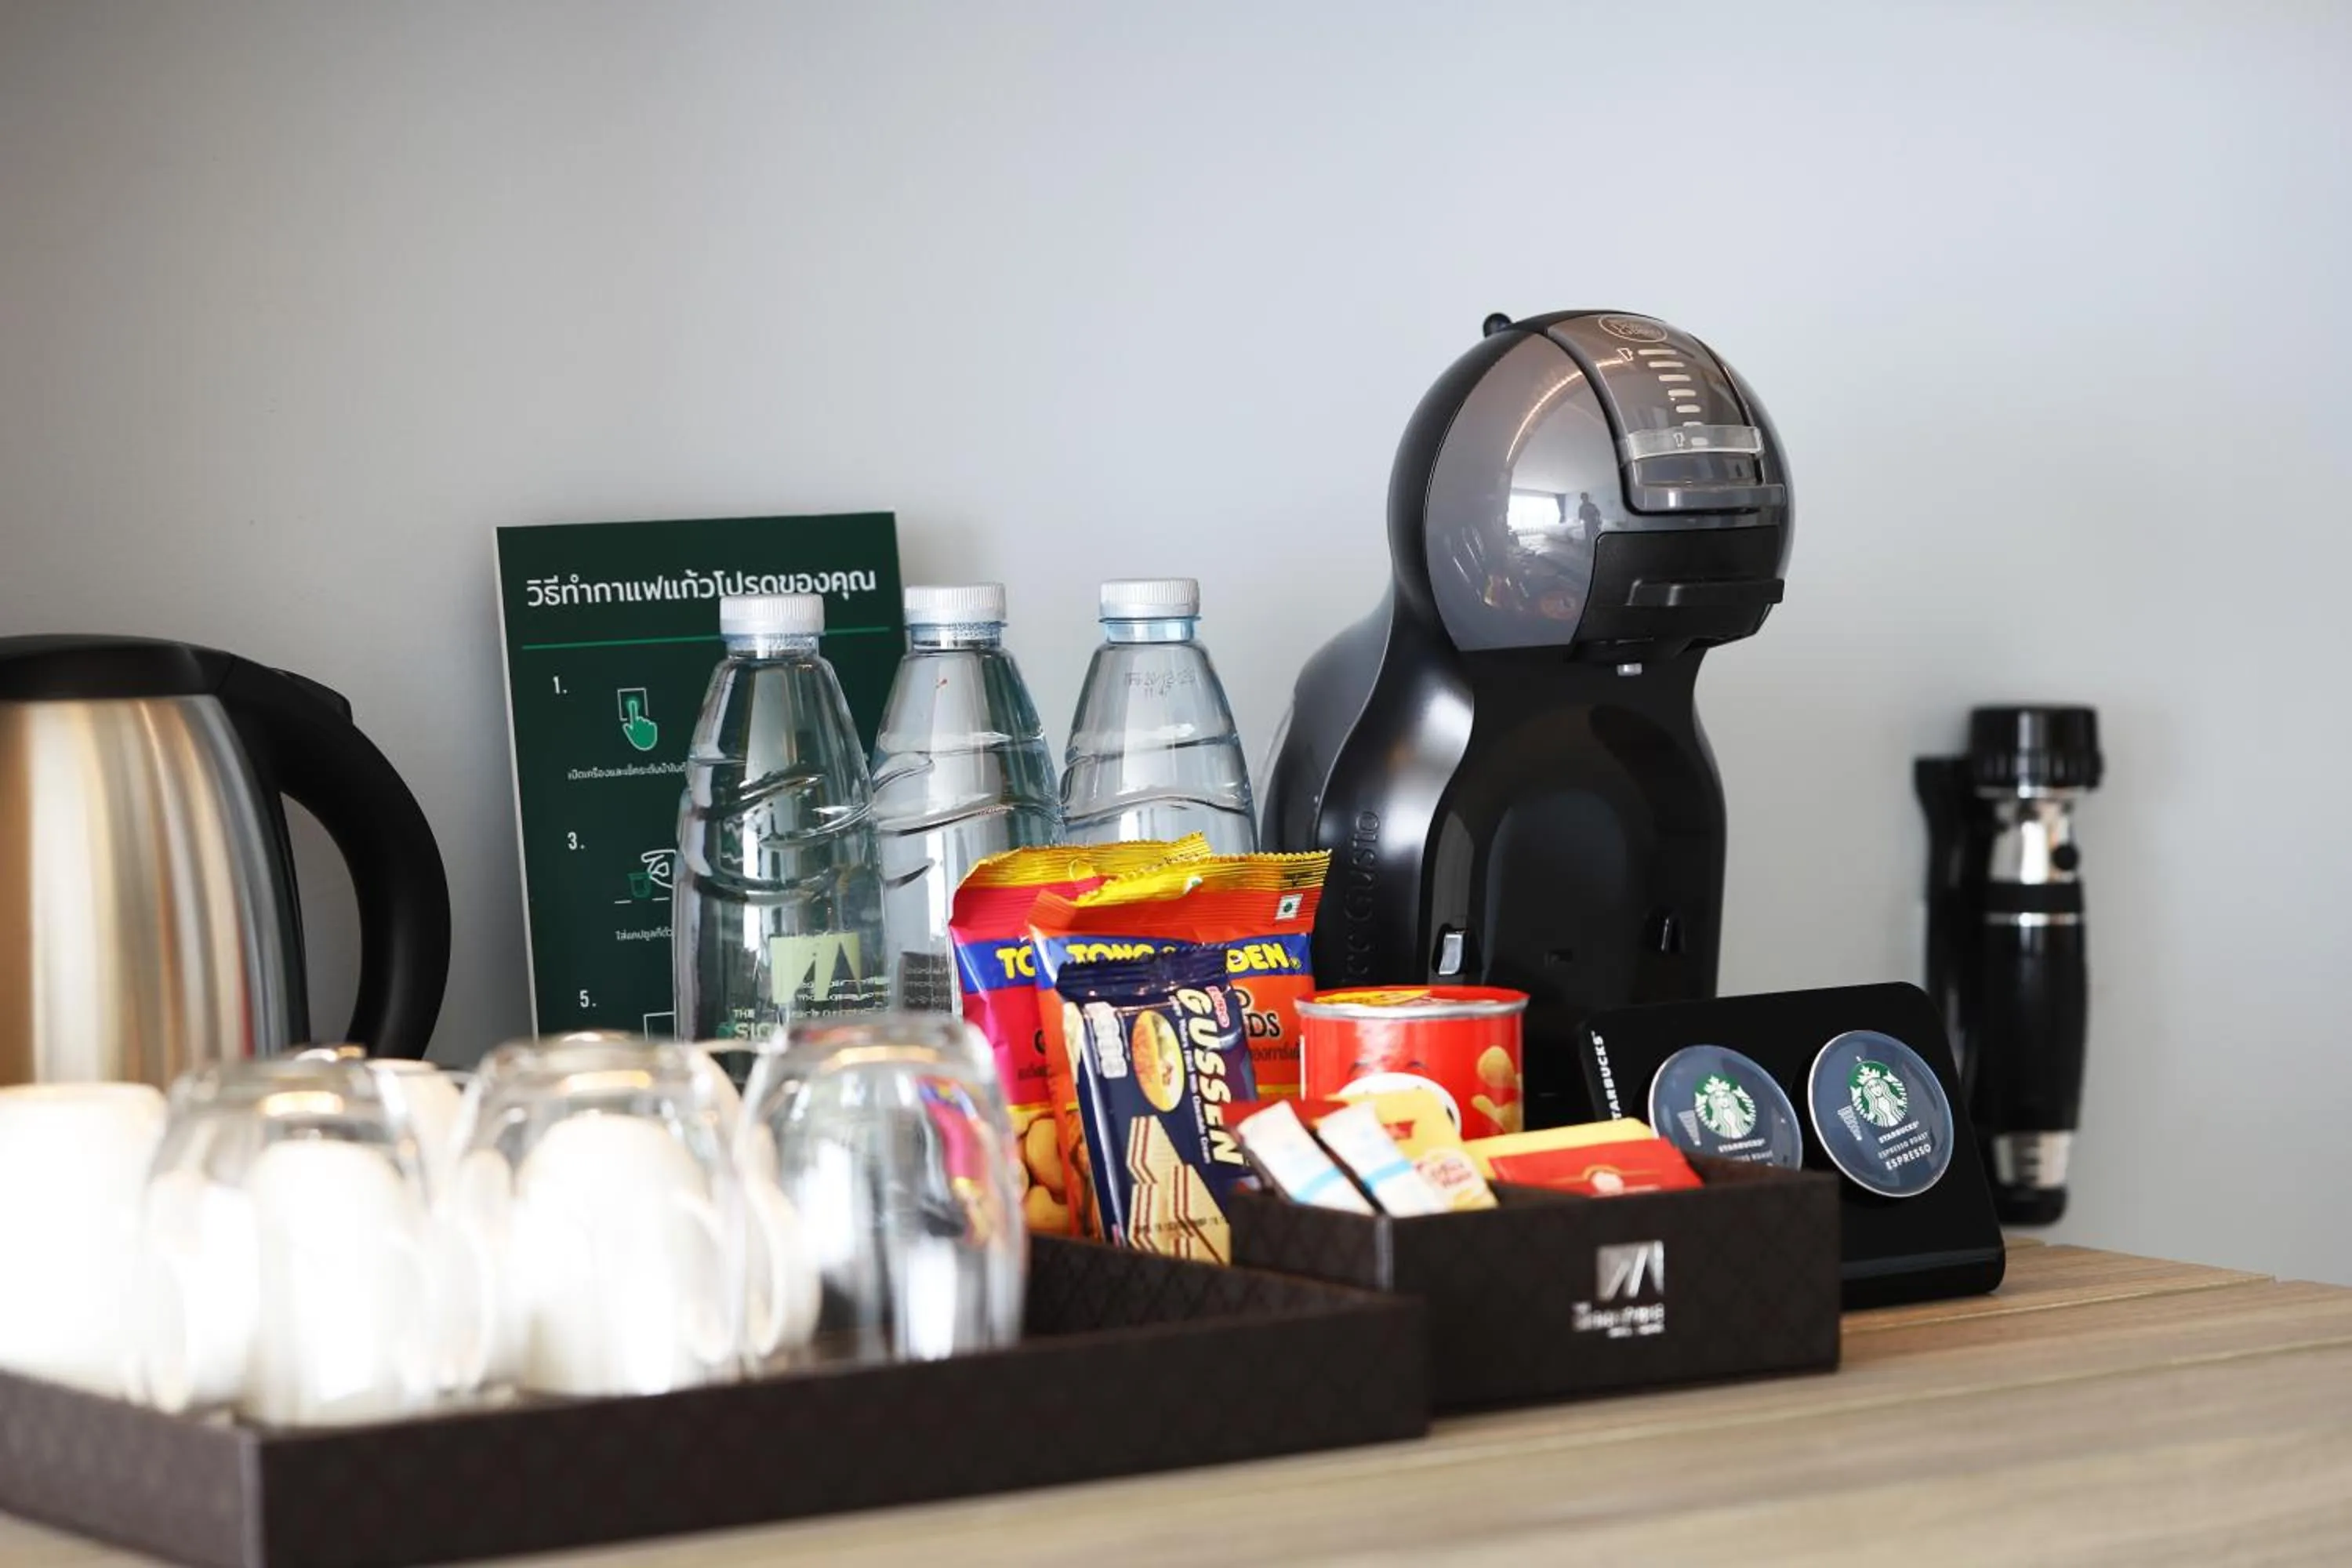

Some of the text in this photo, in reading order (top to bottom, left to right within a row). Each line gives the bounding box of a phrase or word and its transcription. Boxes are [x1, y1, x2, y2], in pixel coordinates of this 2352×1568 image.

[526, 568, 877, 608] วิธีทำกาแฟแก้วโปรดของคุณ
[553, 676, 568, 695] 1.
[568, 832, 586, 850] 3.
[996, 947, 1036, 979] TO
[579, 989, 597, 1008] 5.
[1176, 988, 1245, 1166] GUSSEN
[1591, 1030, 1622, 1120] TARBUCKS
[1886, 1143, 1932, 1171] ESPRESSO
